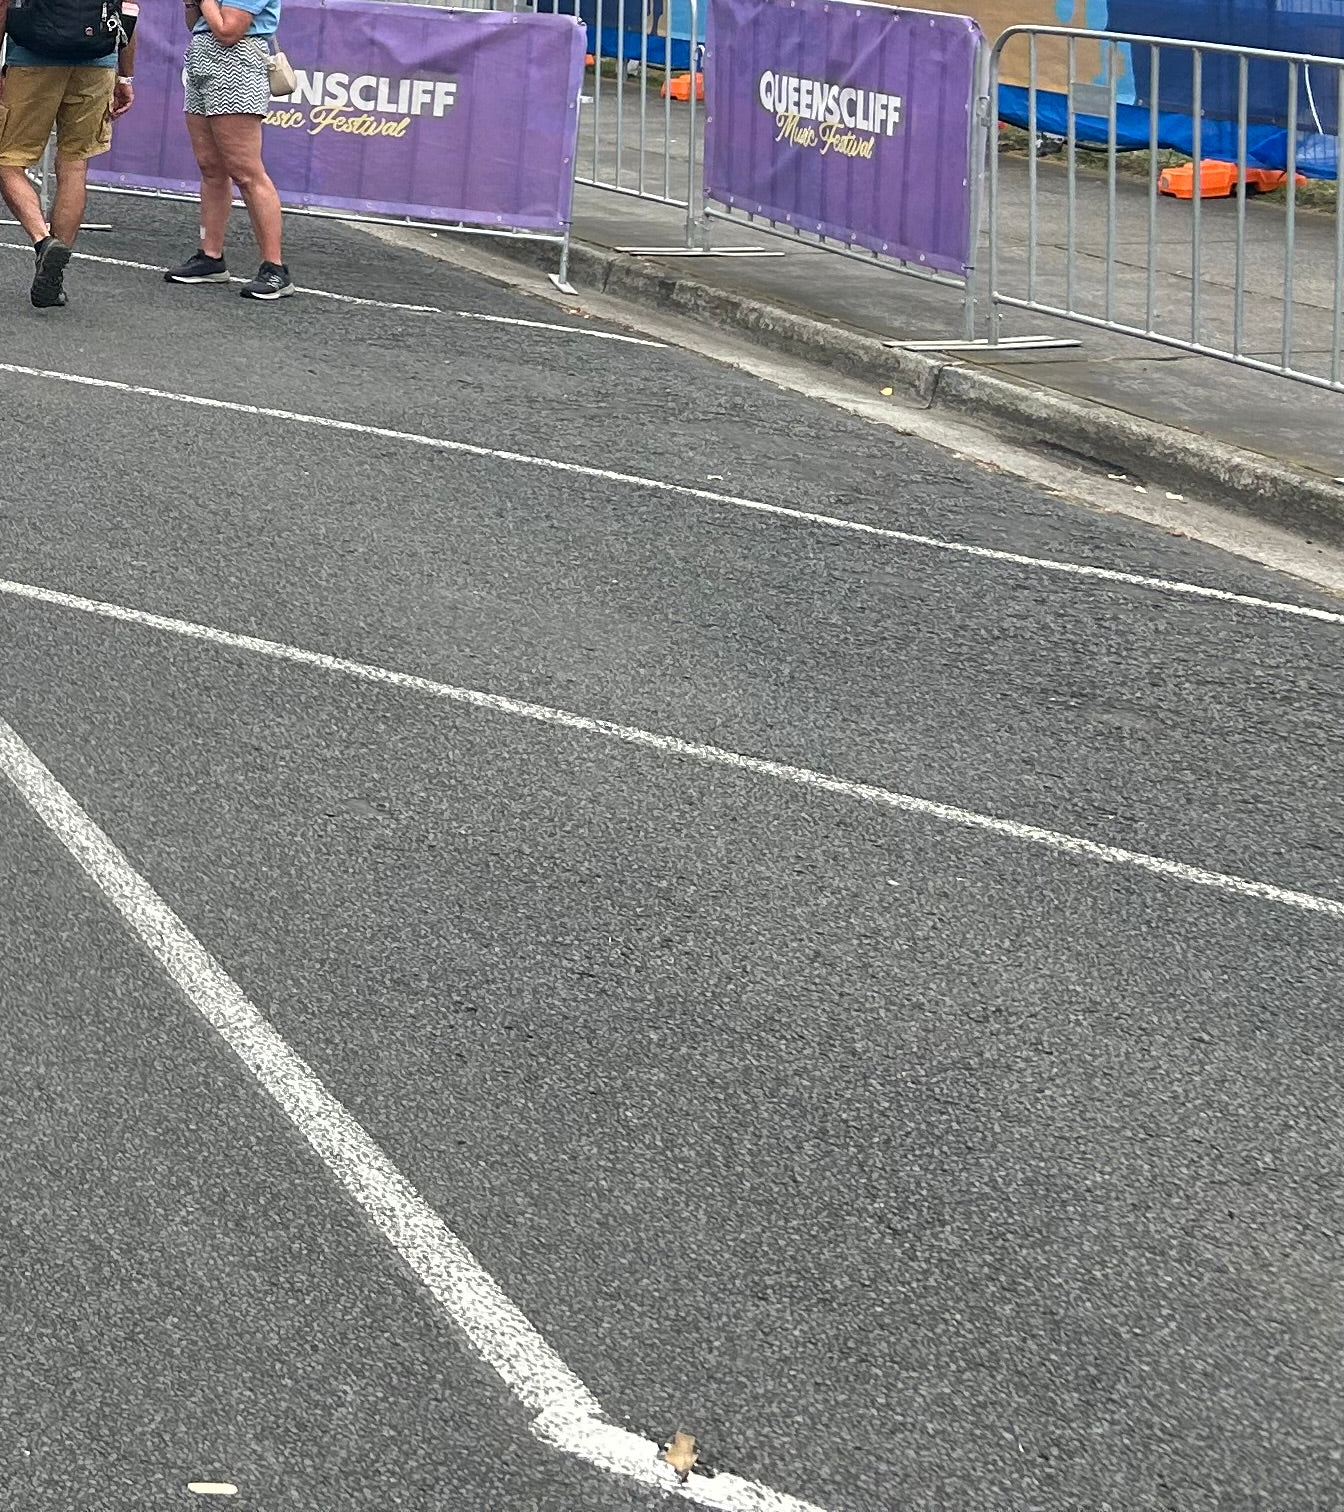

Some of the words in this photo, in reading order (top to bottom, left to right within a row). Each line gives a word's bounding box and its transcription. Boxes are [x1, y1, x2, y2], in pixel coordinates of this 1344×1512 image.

[182, 66, 458, 118] NSCLIFF
[759, 70, 902, 137] QUEENSCLIFF
[260, 107, 306, 130] usic
[306, 104, 409, 138] Festival
[775, 112, 818, 148] Music
[818, 121, 875, 160] Festival
